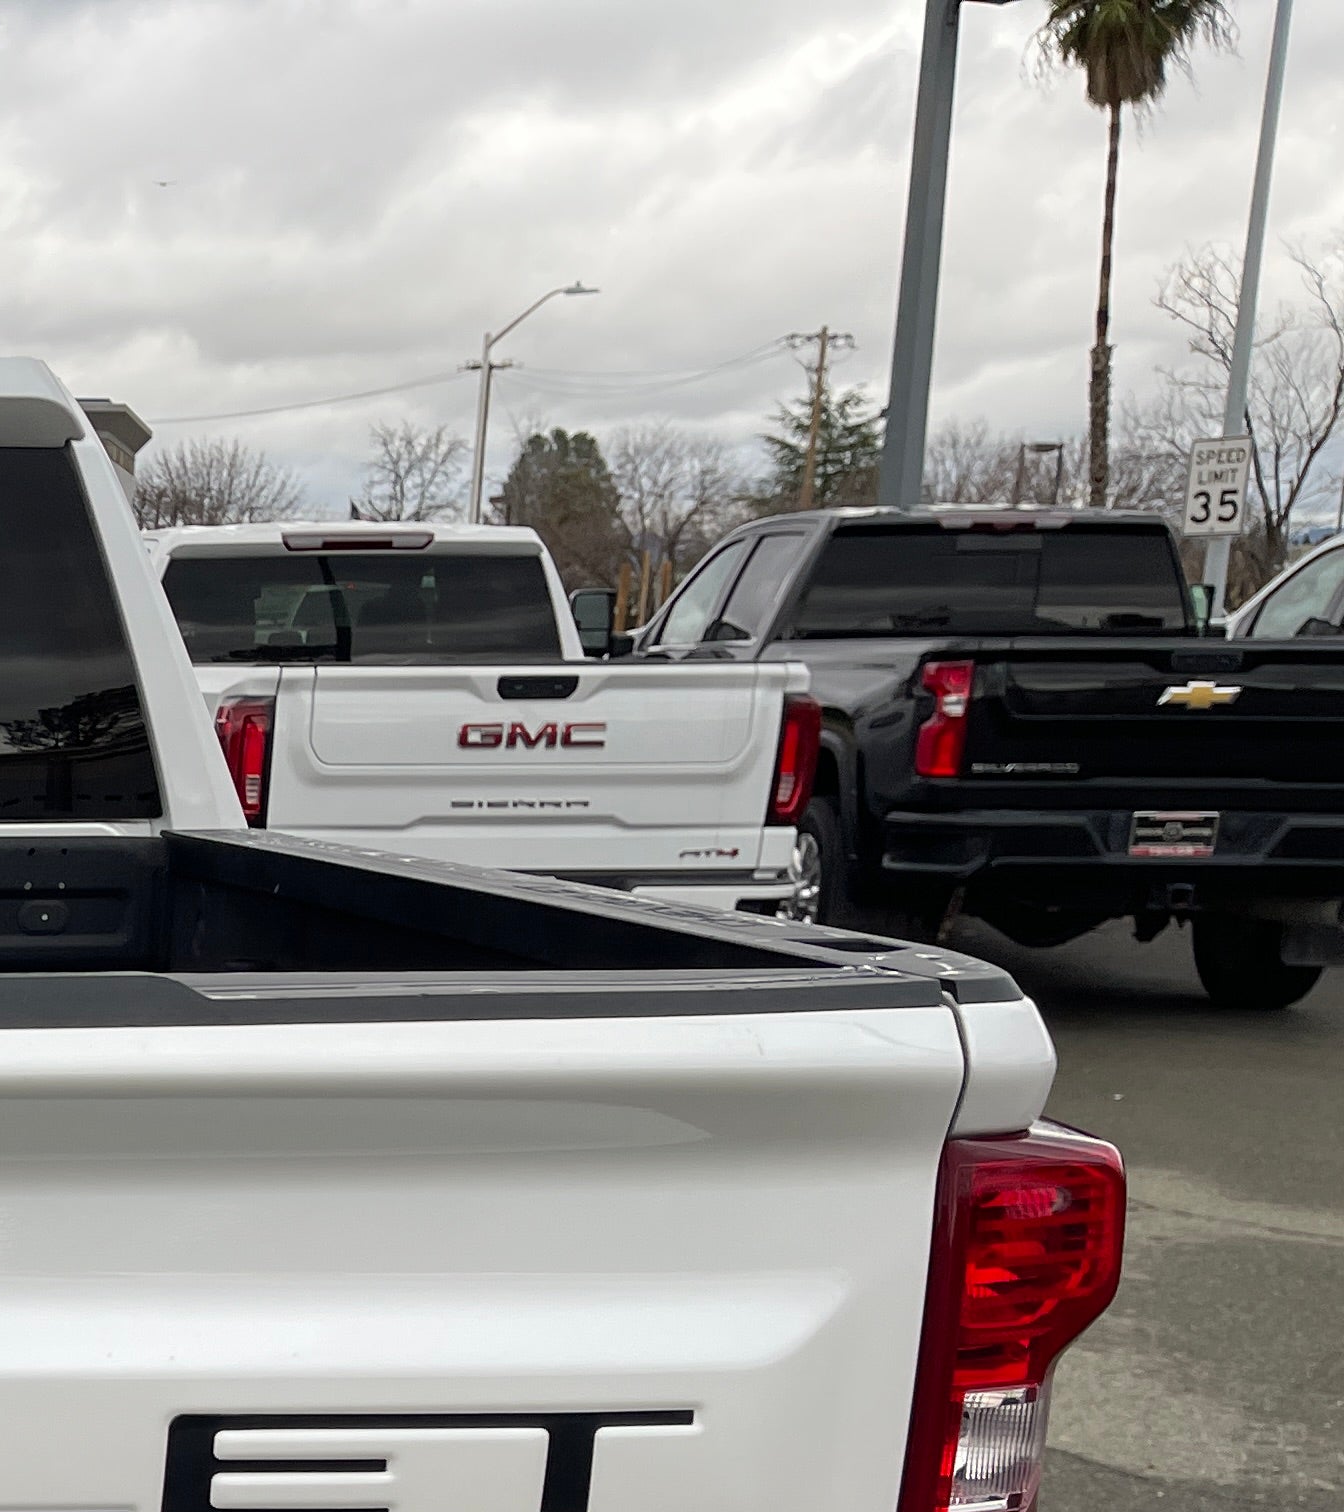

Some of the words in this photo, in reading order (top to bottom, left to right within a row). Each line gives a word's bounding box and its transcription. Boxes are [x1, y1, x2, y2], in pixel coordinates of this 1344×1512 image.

[1196, 447, 1246, 465] SPEED
[1198, 468, 1238, 485] LIMIT
[1191, 489, 1239, 523] 35
[458, 722, 607, 750] GMC
